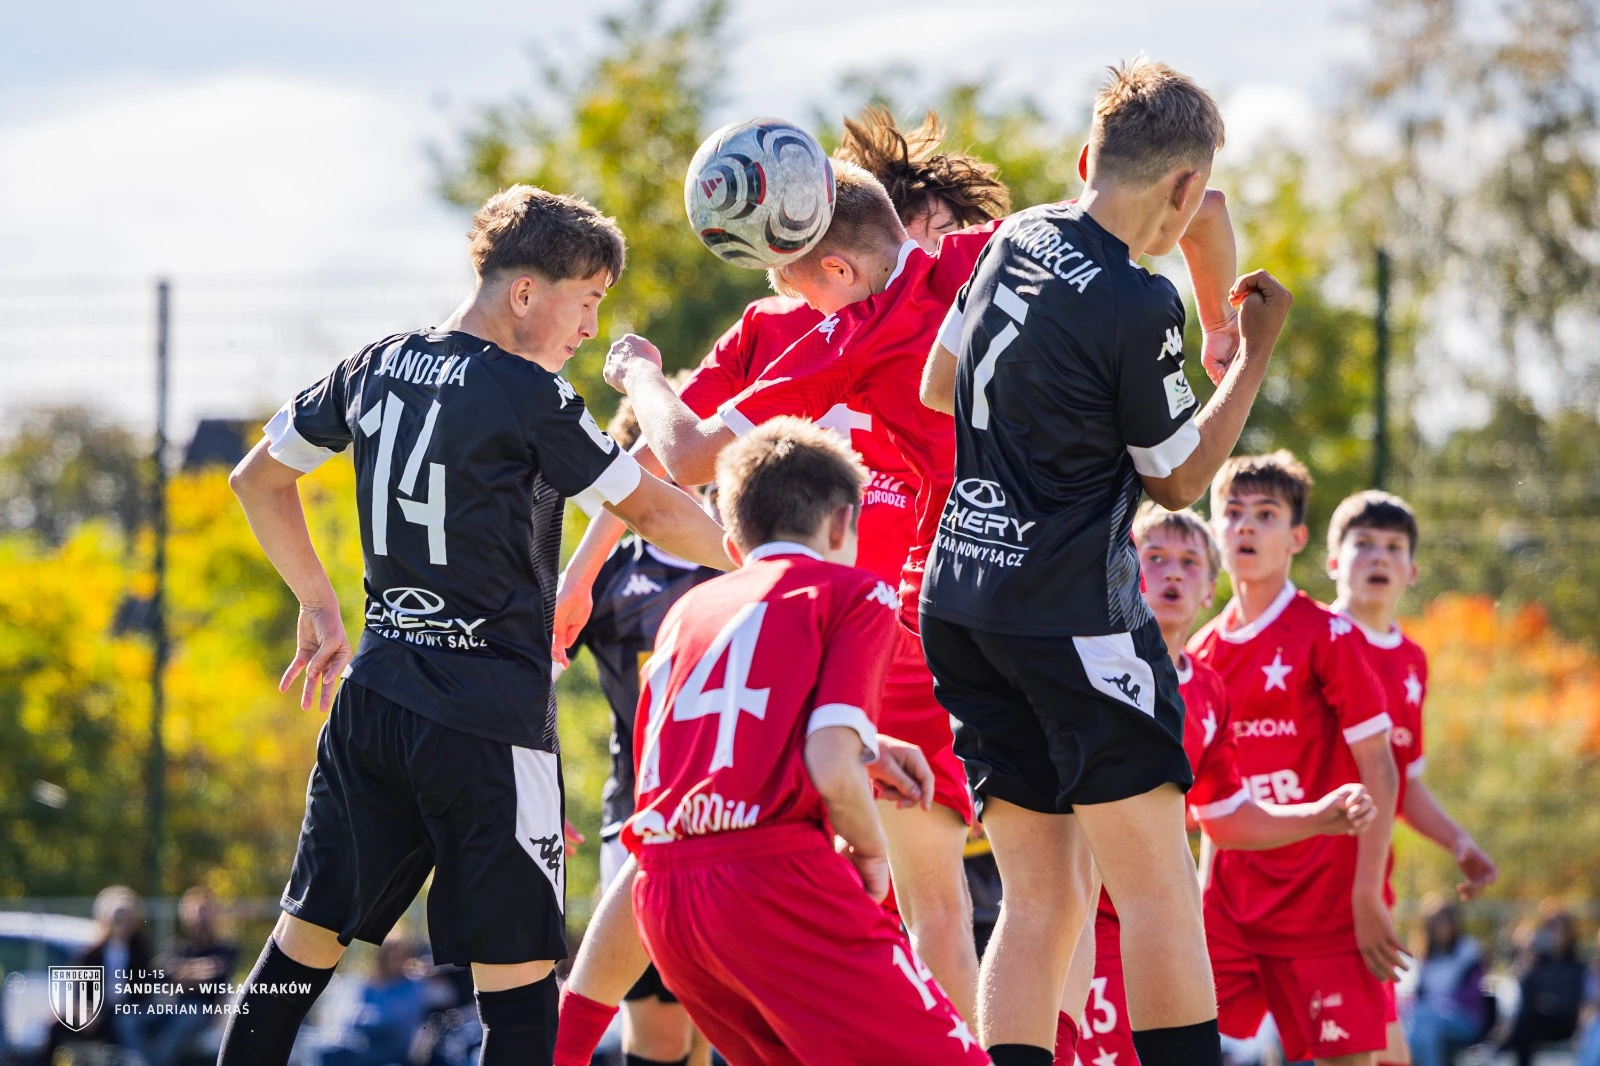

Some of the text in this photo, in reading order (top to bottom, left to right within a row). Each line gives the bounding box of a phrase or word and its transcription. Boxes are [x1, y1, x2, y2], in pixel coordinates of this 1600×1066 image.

[971, 282, 1030, 431] 7
[358, 390, 448, 566] 14
[867, 490, 907, 509] DRODZE
[956, 540, 990, 561] NOWY
[989, 547, 1025, 568] SĄCZ
[637, 601, 771, 795] 14
